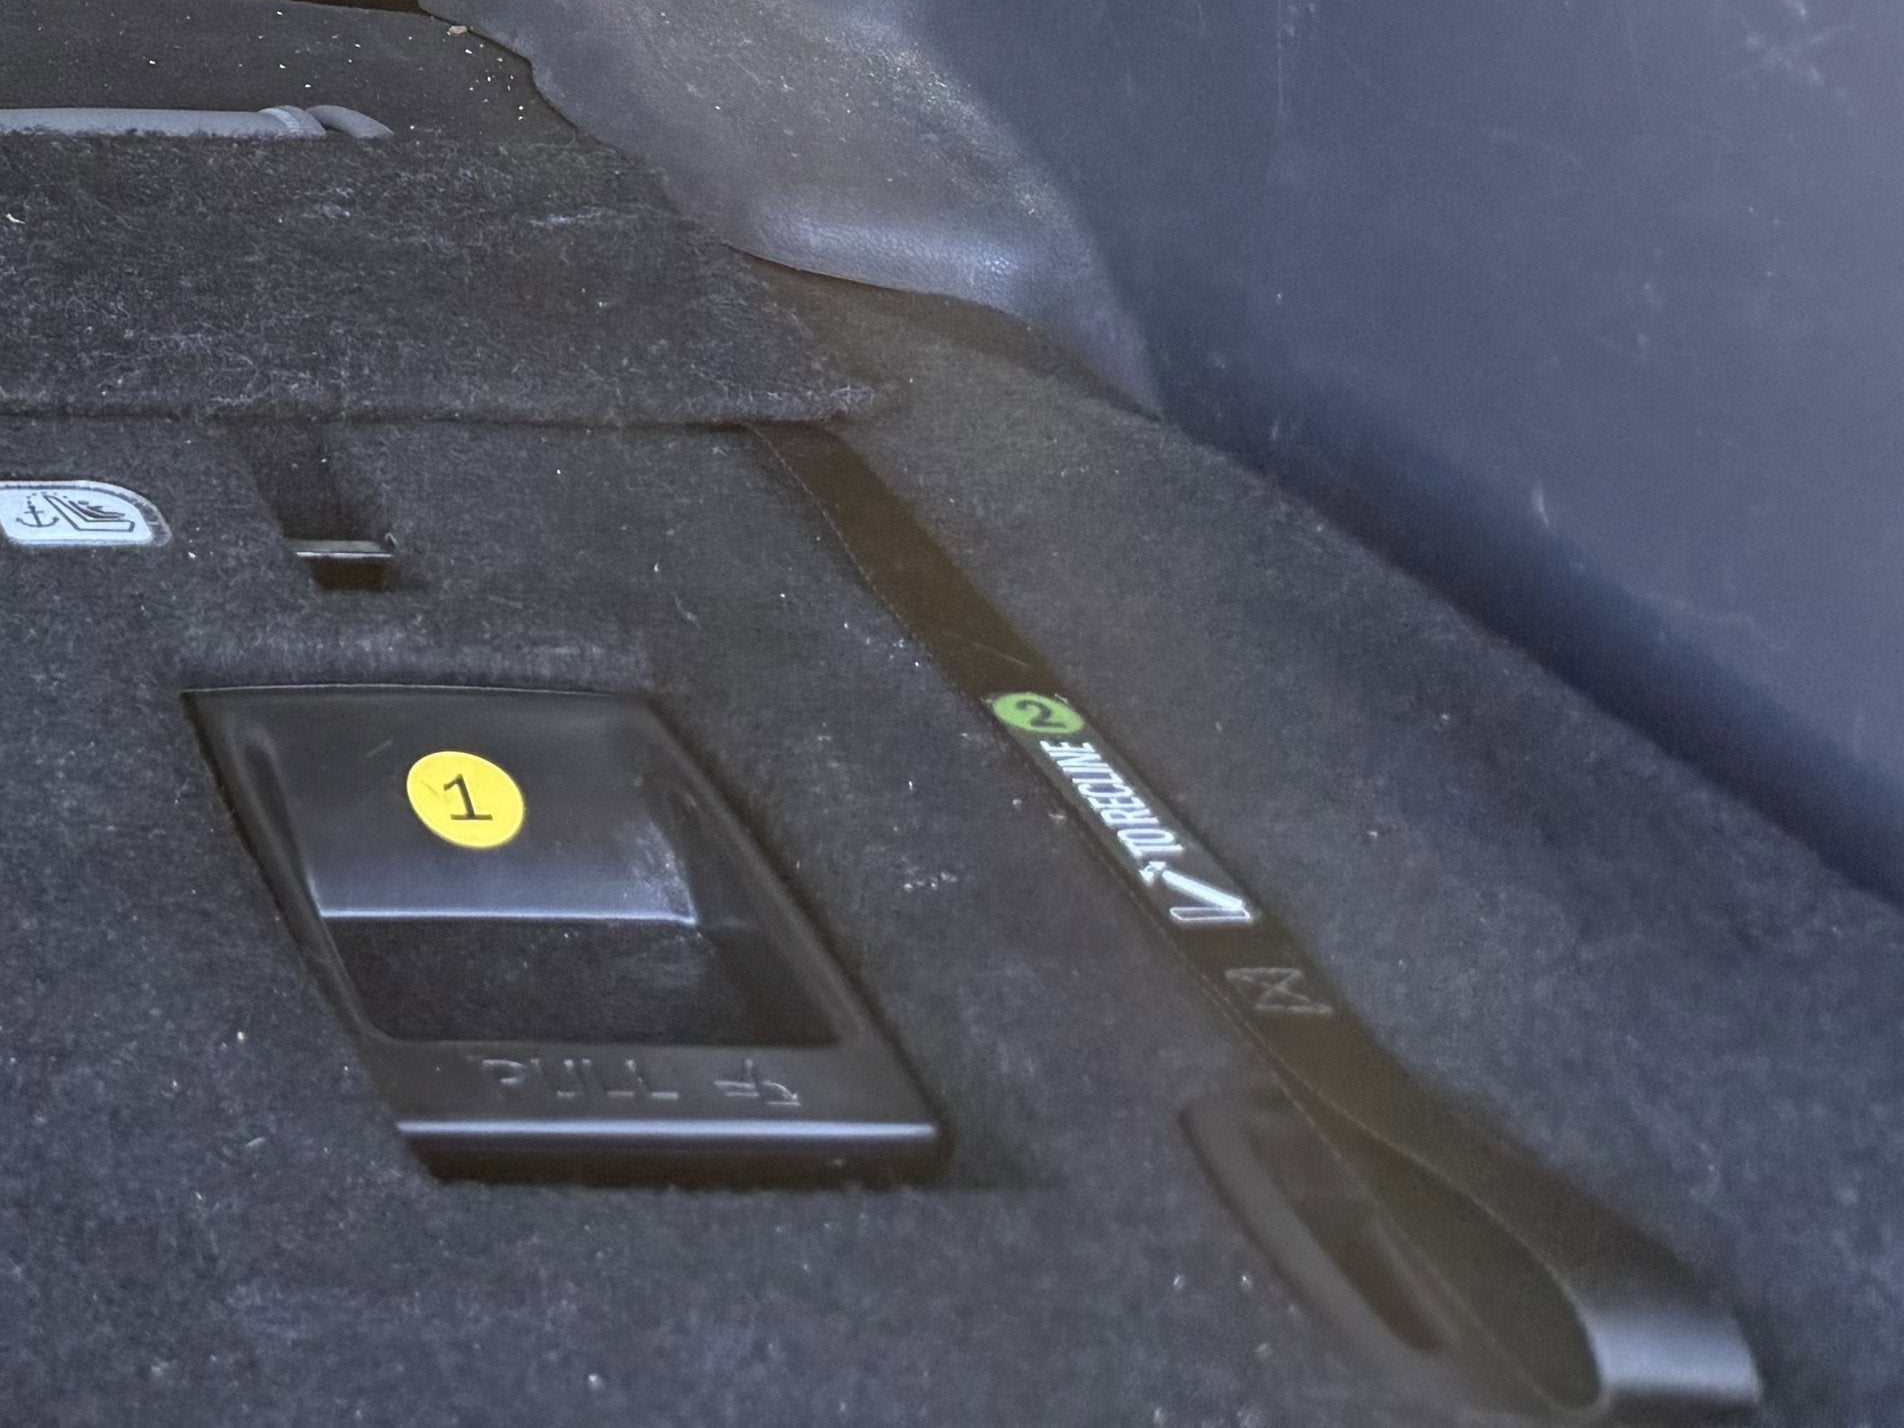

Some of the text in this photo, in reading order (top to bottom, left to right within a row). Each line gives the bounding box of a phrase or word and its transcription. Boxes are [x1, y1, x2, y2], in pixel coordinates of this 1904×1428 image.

[1016, 700, 1068, 729] 2
[442, 773, 494, 821] 1
[1040, 740, 1184, 859] TO RECLINE
